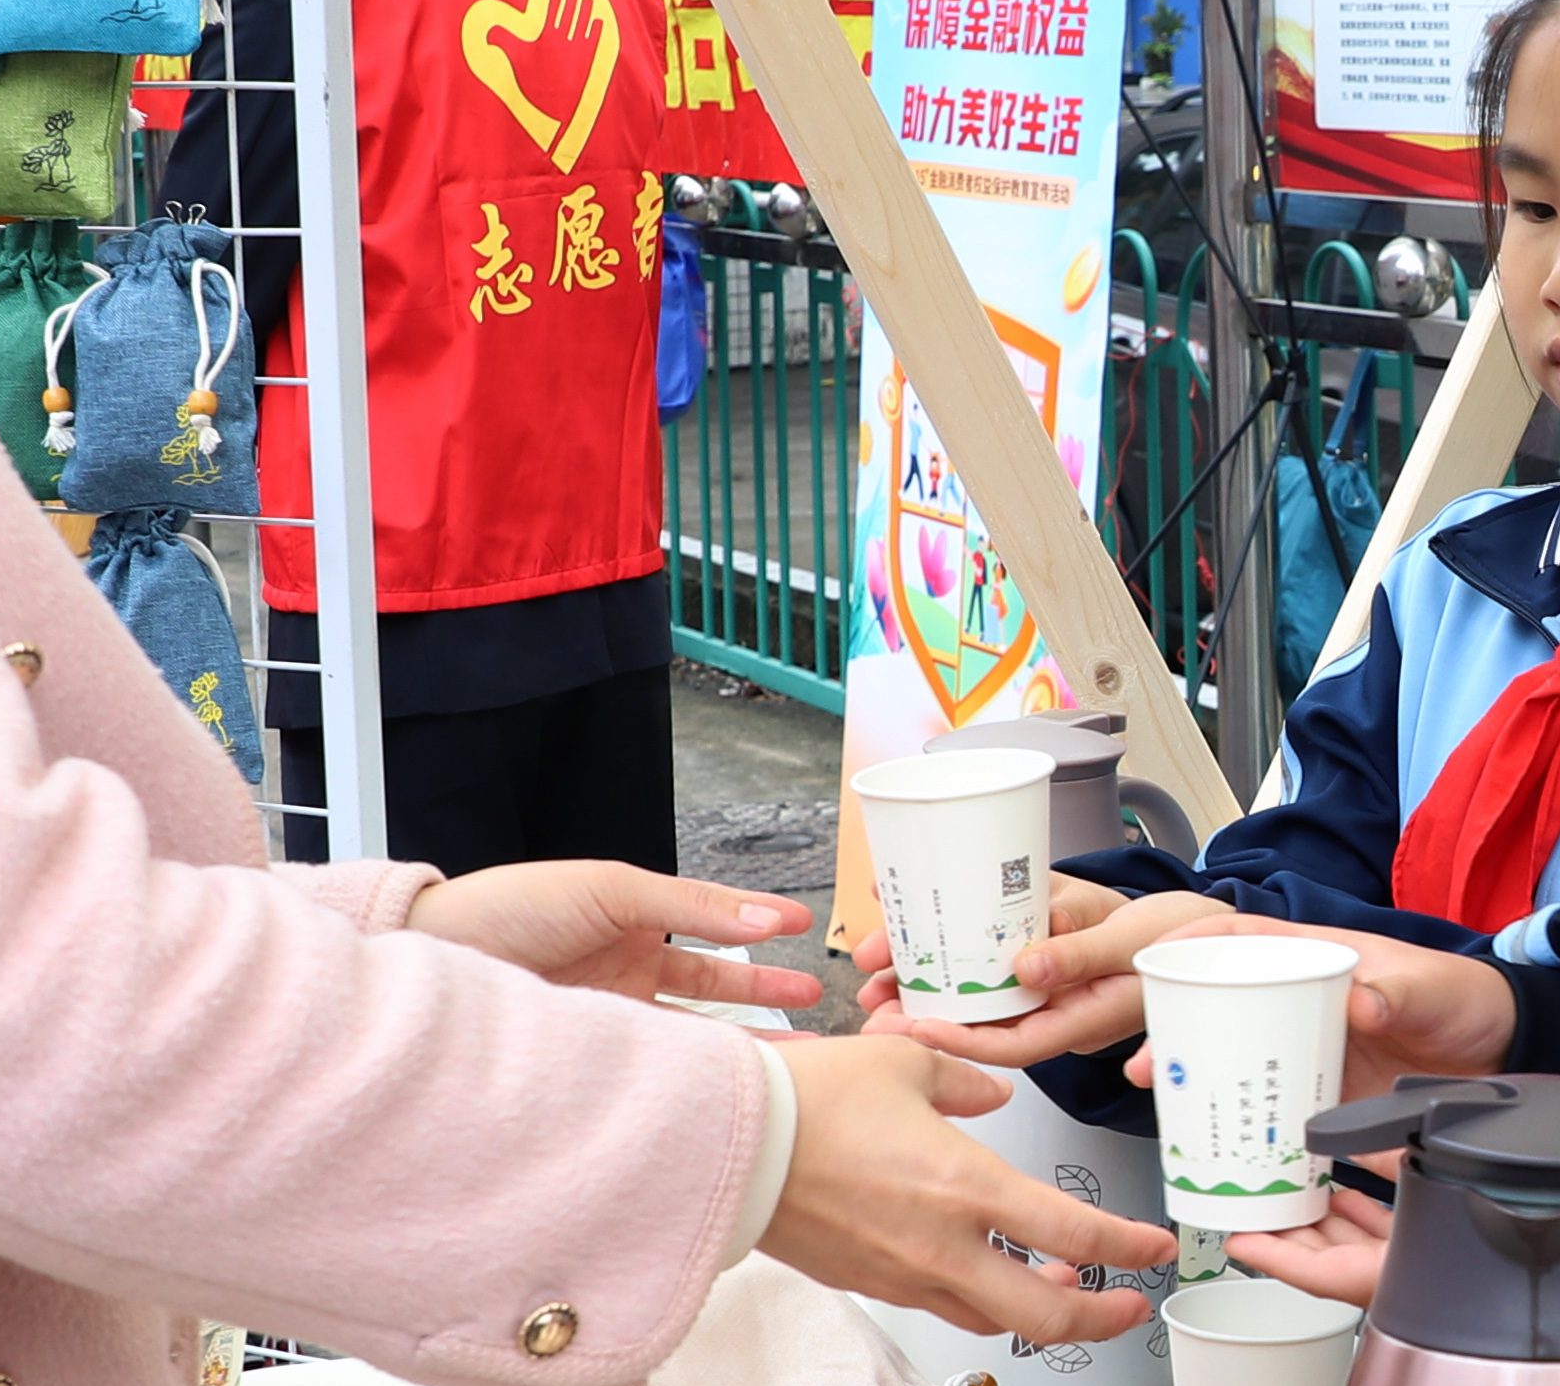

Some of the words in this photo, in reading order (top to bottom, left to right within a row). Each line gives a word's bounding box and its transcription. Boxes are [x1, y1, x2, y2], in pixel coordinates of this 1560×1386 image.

[901, 85, 1084, 157] 助力美好生活
[468, 171, 662, 325] 志愿者
